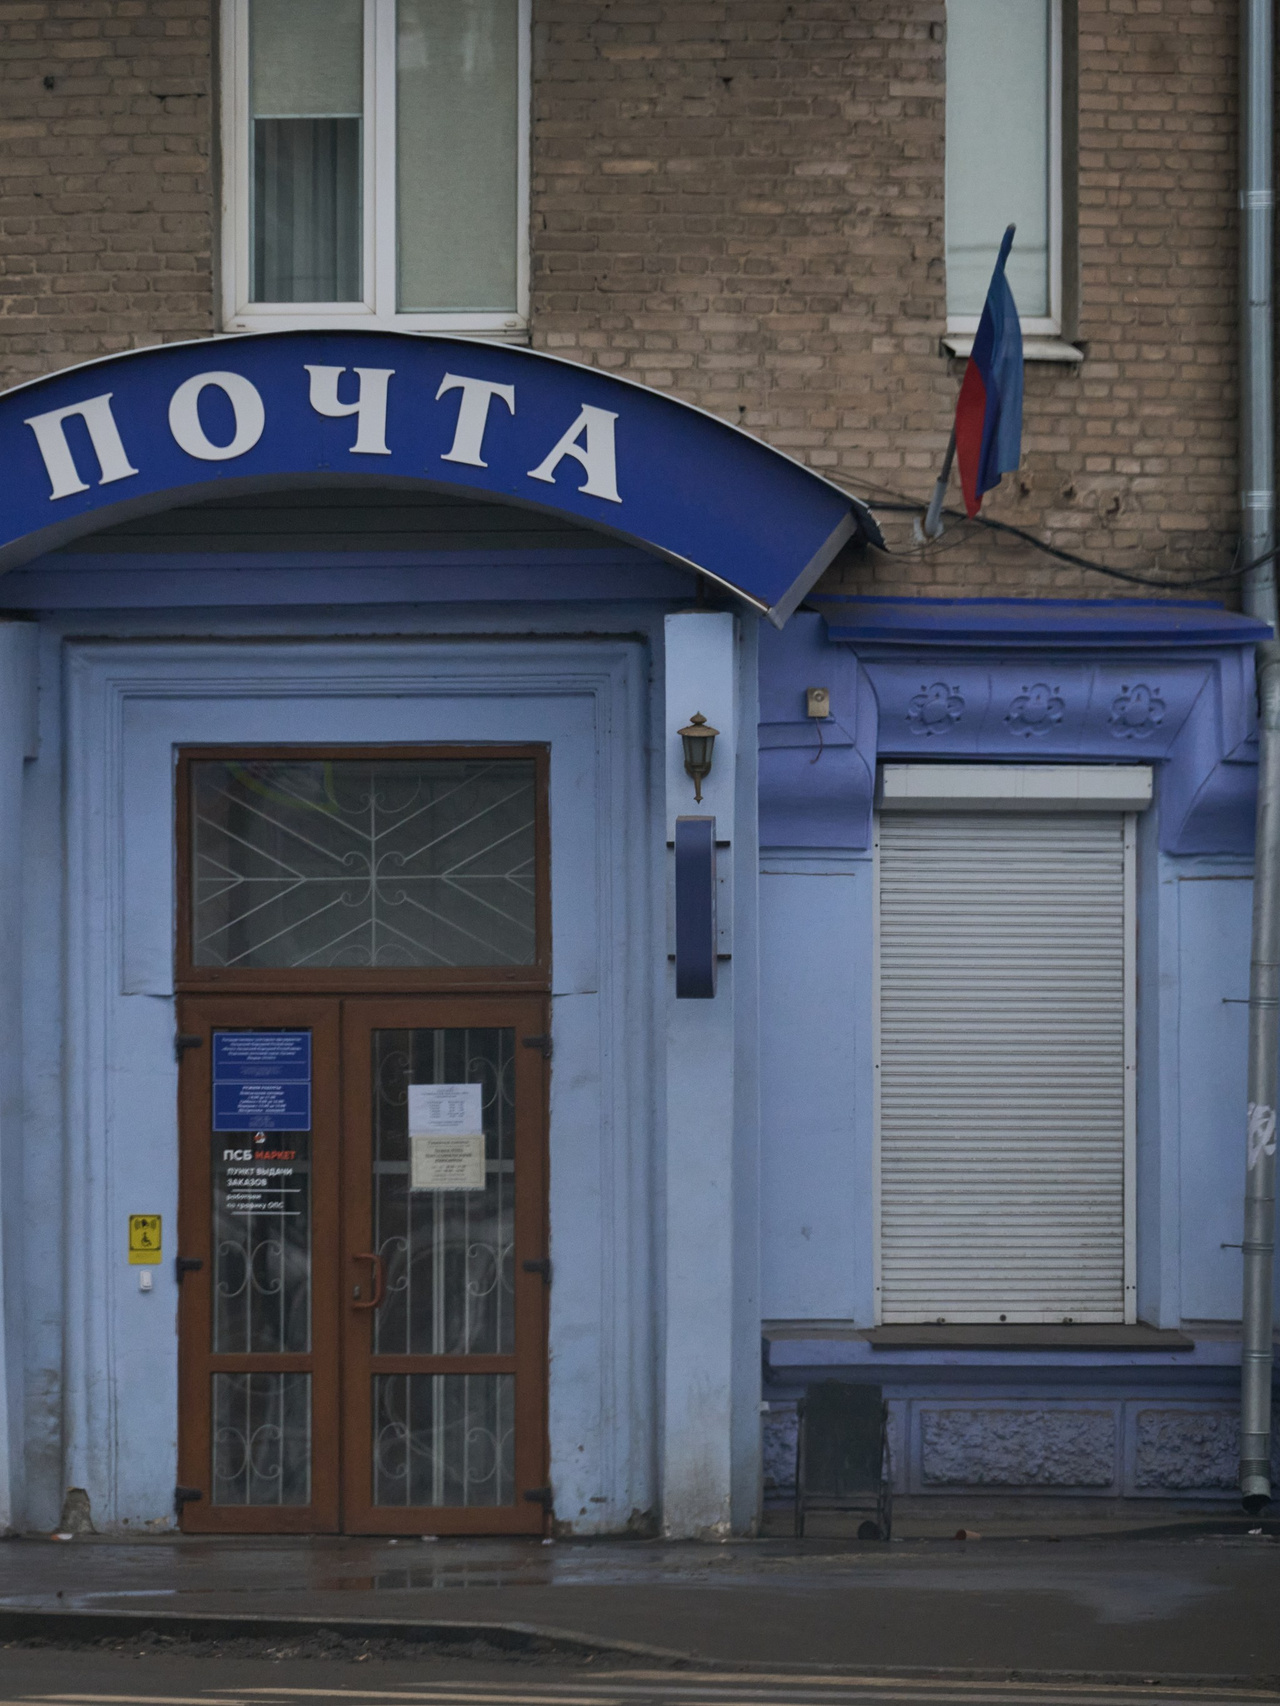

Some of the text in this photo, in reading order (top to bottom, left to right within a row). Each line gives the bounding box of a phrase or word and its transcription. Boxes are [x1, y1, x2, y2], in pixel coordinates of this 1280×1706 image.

[24, 364, 623, 503] ПОЧТА
[223, 1149, 252, 1161] ПСБ
[227, 1167, 293, 1177] ПУНКТ ВЫДАЧИ
[227, 1178, 267, 1187] ЗАКАЗОВ
